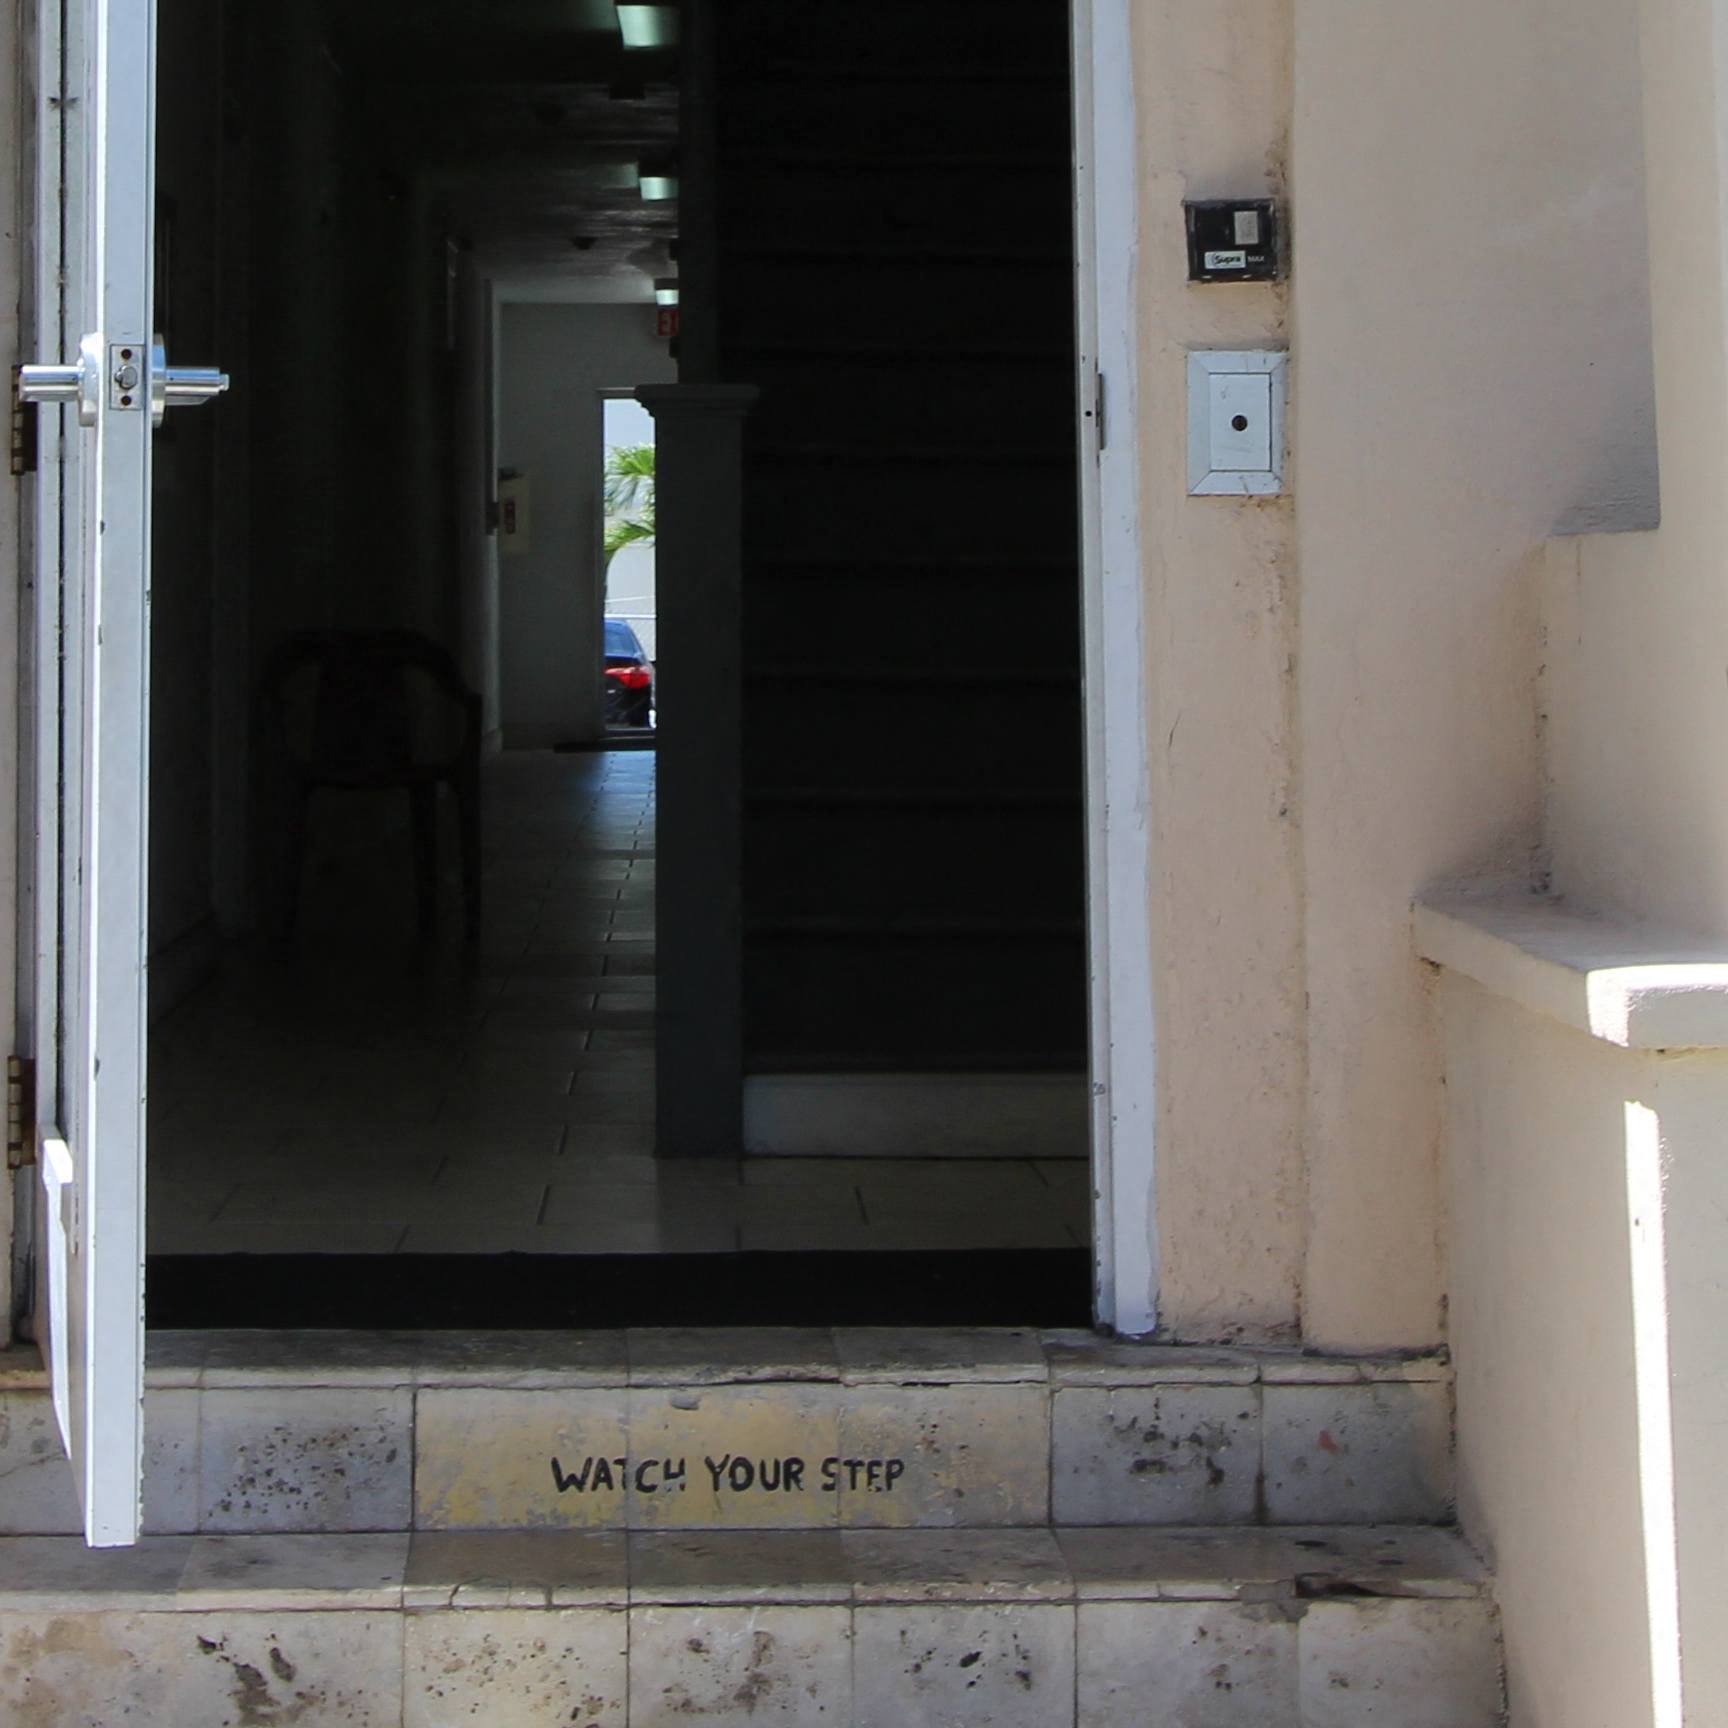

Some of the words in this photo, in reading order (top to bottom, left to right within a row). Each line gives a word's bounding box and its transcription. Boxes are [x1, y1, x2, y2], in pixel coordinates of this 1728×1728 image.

[550, 1456, 687, 1494] WATCH
[703, 1453, 806, 1494] YOUR
[821, 1457, 906, 1494] STEP
